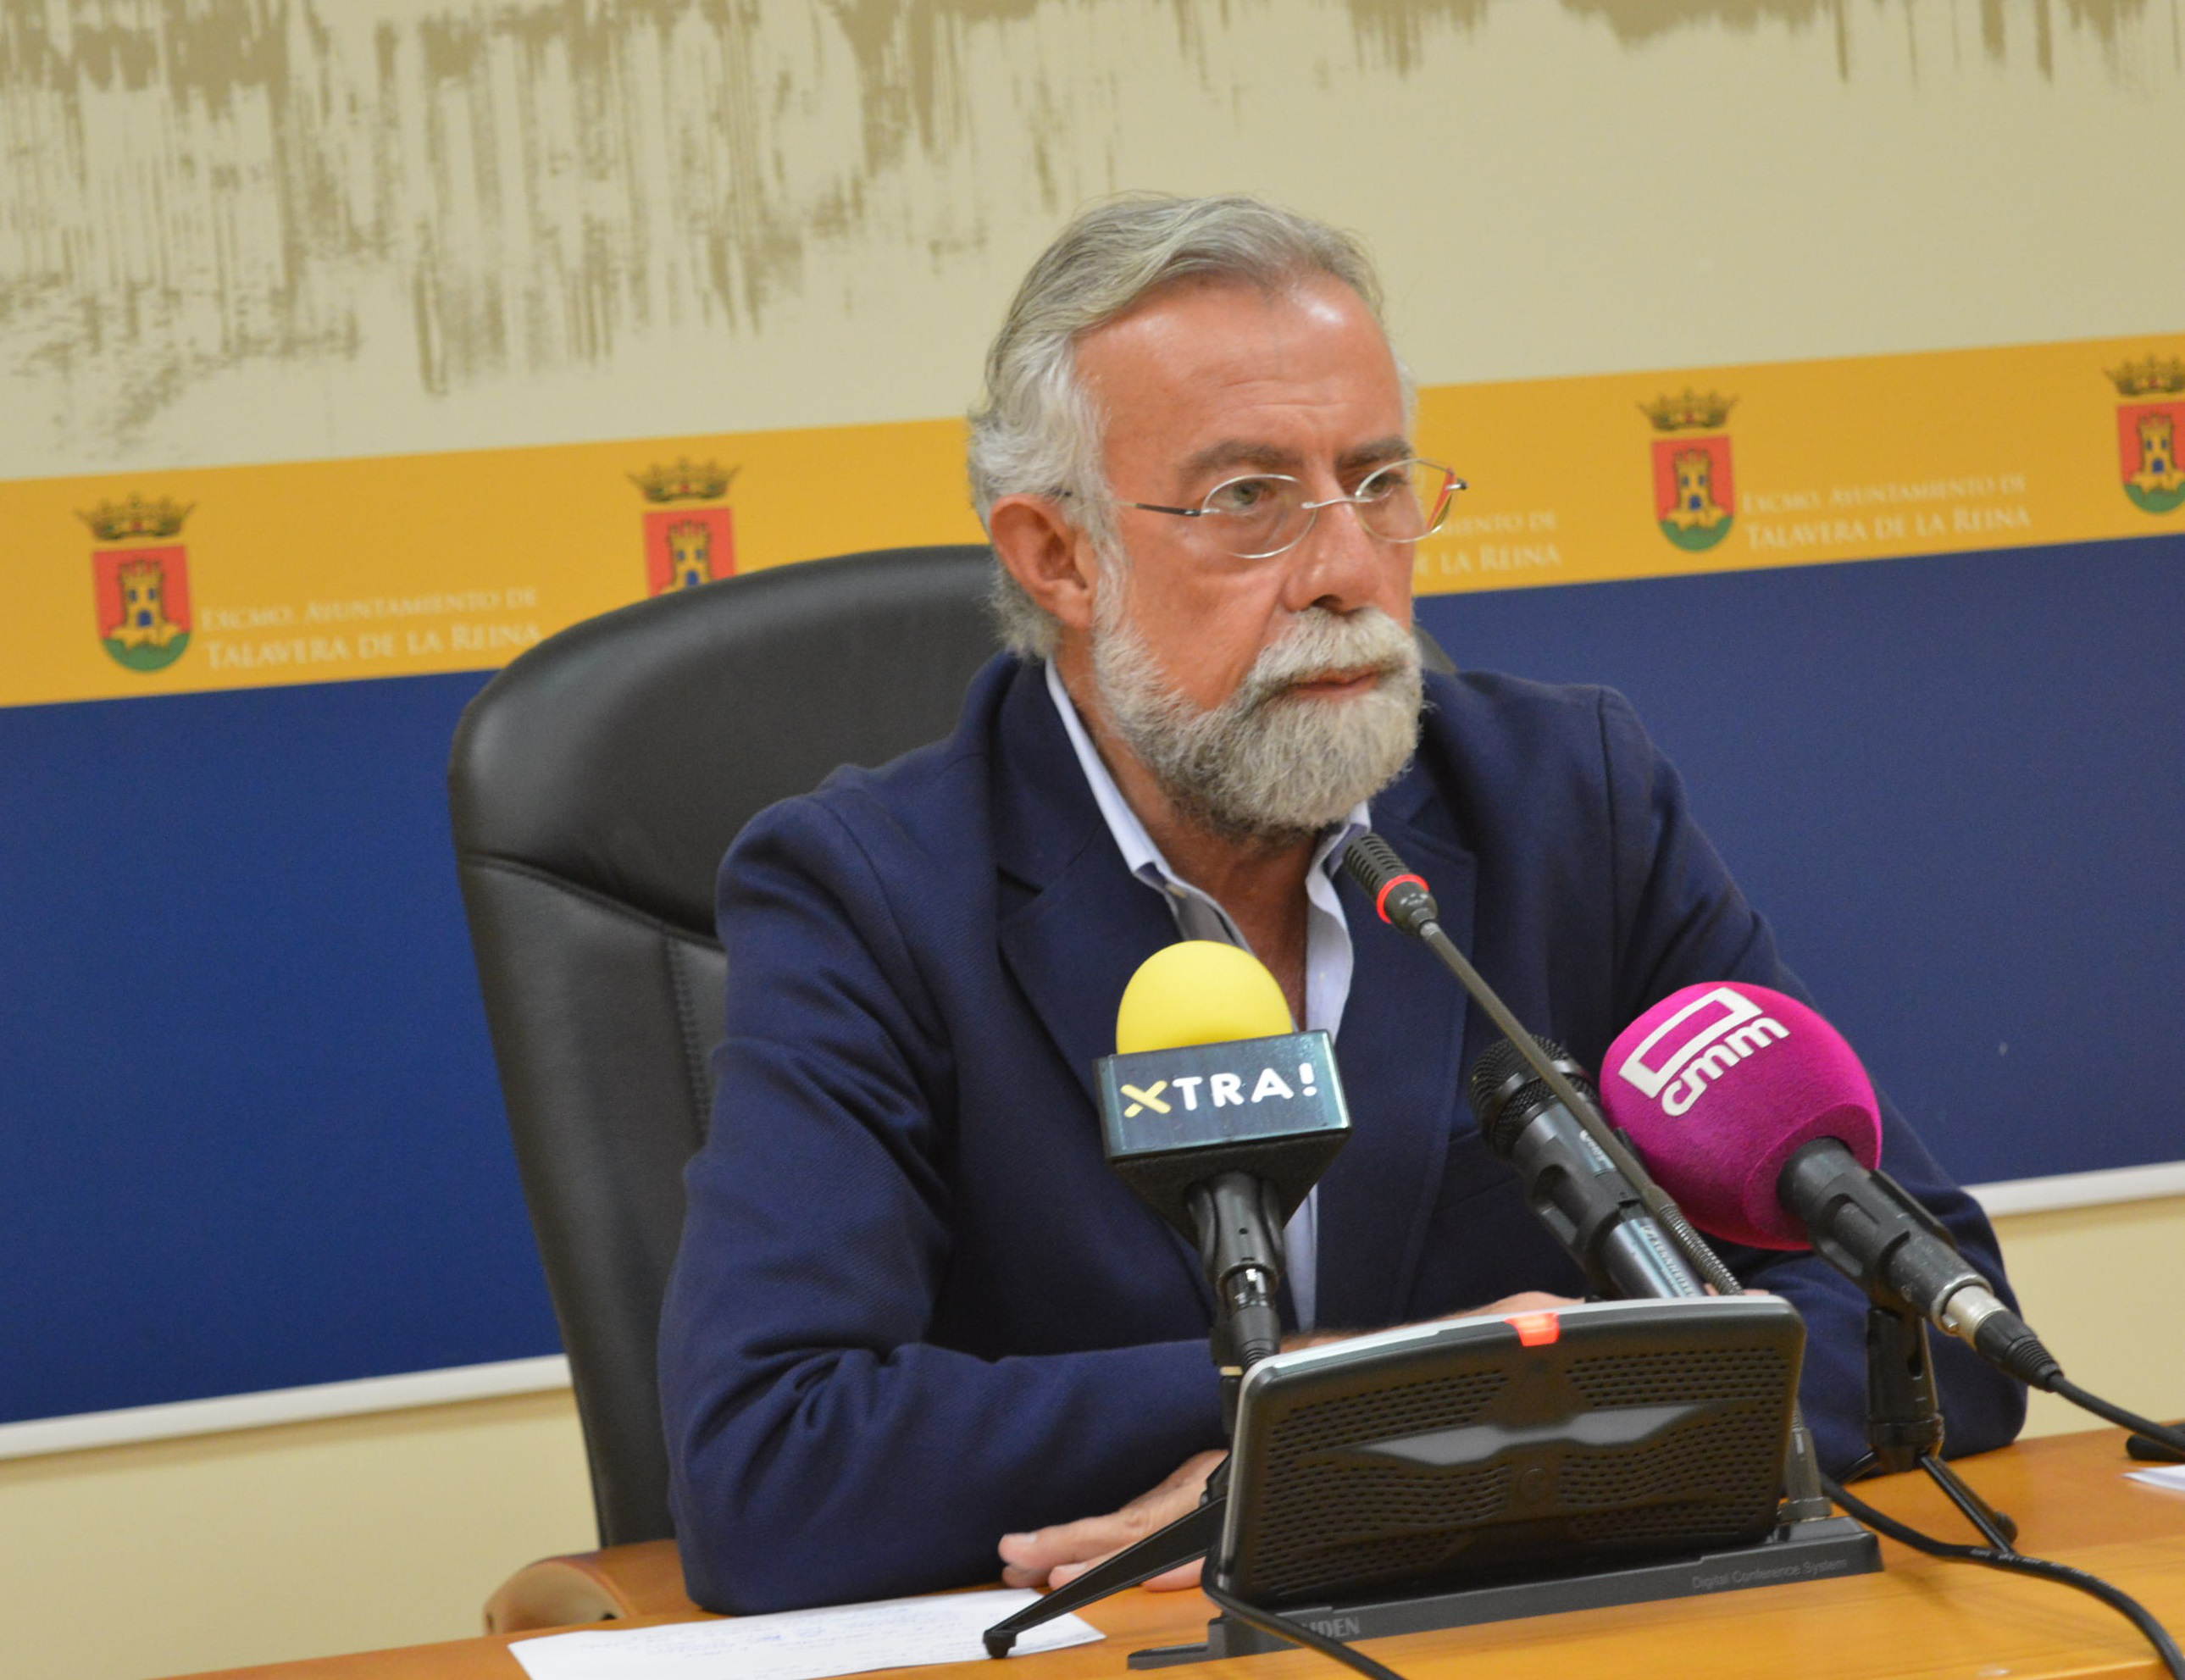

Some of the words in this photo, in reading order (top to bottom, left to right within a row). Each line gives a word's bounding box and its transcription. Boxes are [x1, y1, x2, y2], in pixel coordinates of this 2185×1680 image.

[1743, 518, 1869, 551] TALAVERA
[1874, 515, 1905, 541] DE
[1913, 511, 1946, 536] LA
[1953, 505, 2032, 534] REINA
[1440, 549, 1472, 575] LA
[1480, 542, 1563, 573] REINA
[206, 635, 352, 670] TALAVERA
[358, 633, 394, 659] DE
[407, 630, 444, 656] LA
[451, 623, 542, 651] REINA
[1120, 1062, 1317, 1118] XTRA!
[1692, 1573, 1729, 1590] Digital
[1731, 1566, 1801, 1583] Conference
[1802, 1559, 1848, 1575] System
